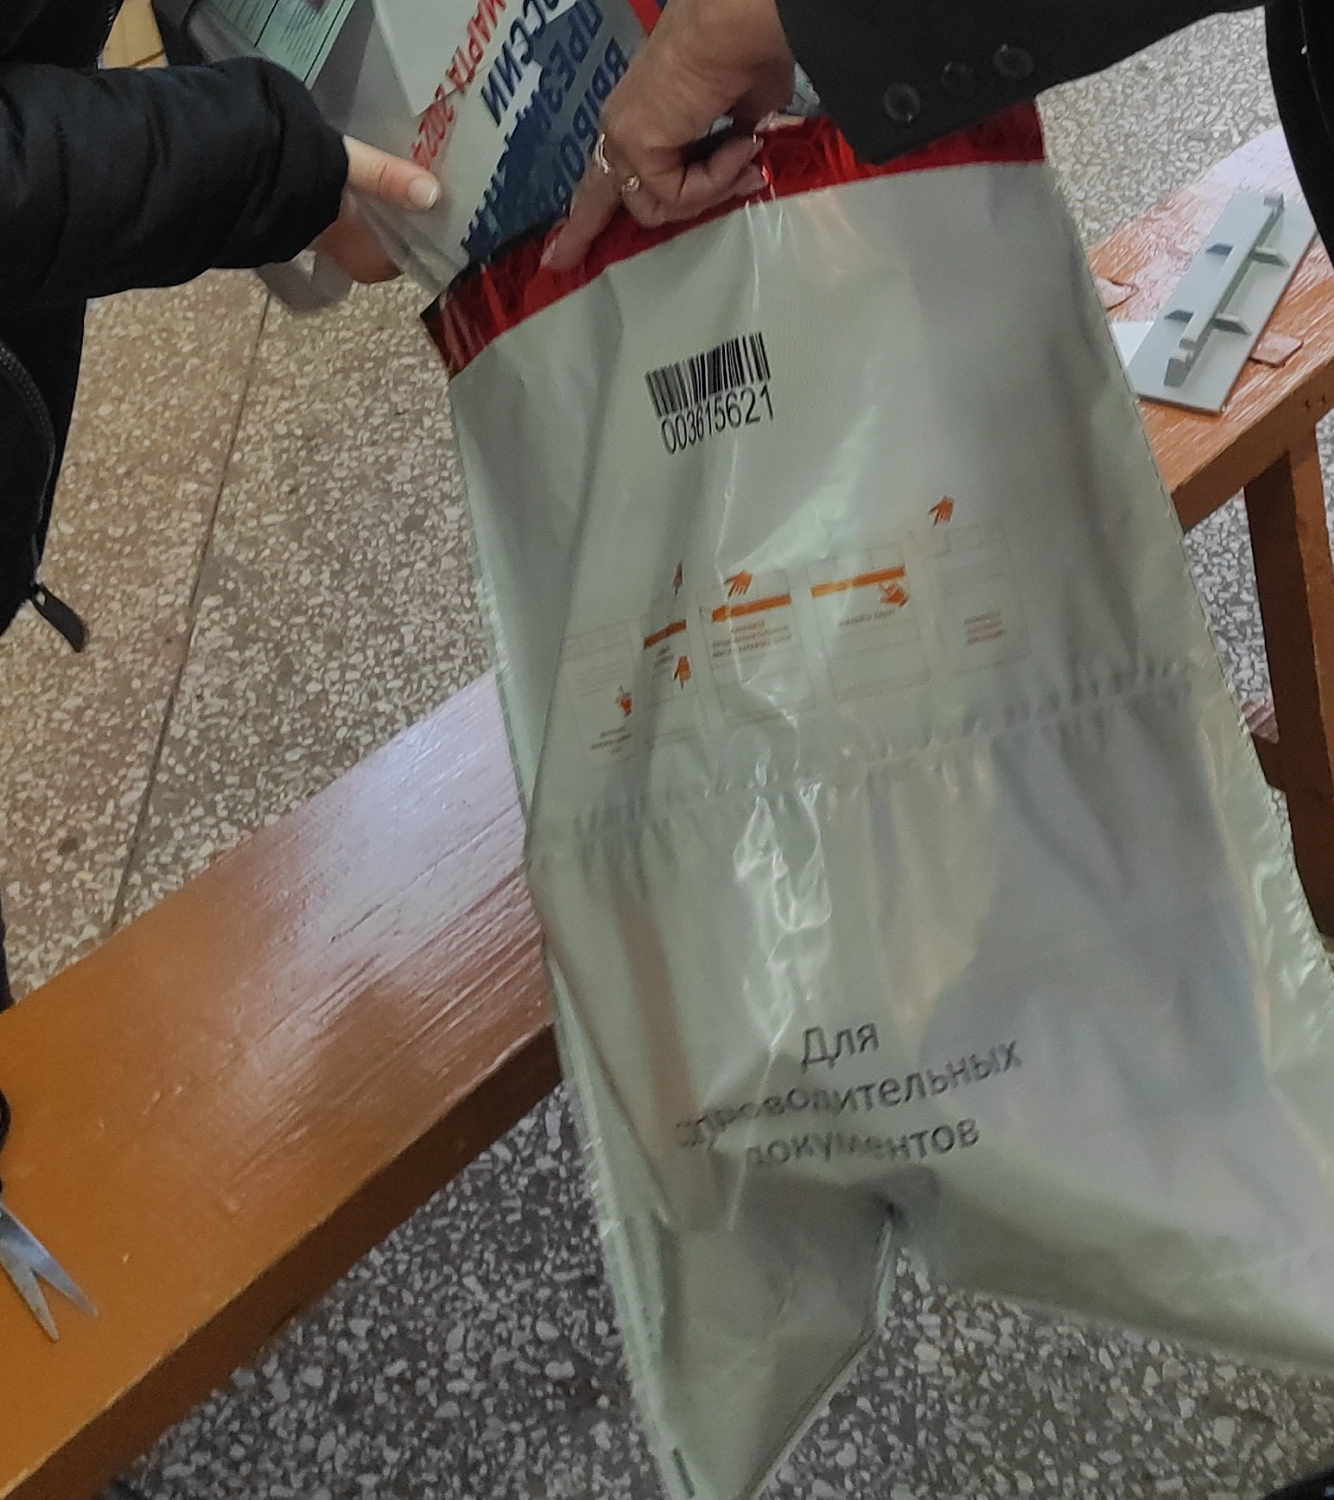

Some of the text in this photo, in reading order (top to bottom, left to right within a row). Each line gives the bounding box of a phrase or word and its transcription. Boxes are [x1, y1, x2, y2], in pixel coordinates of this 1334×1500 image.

[660, 383, 774, 456] 003615621
[800, 1021, 880, 1073] Для
[675, 1040, 1023, 1149] проводительных
